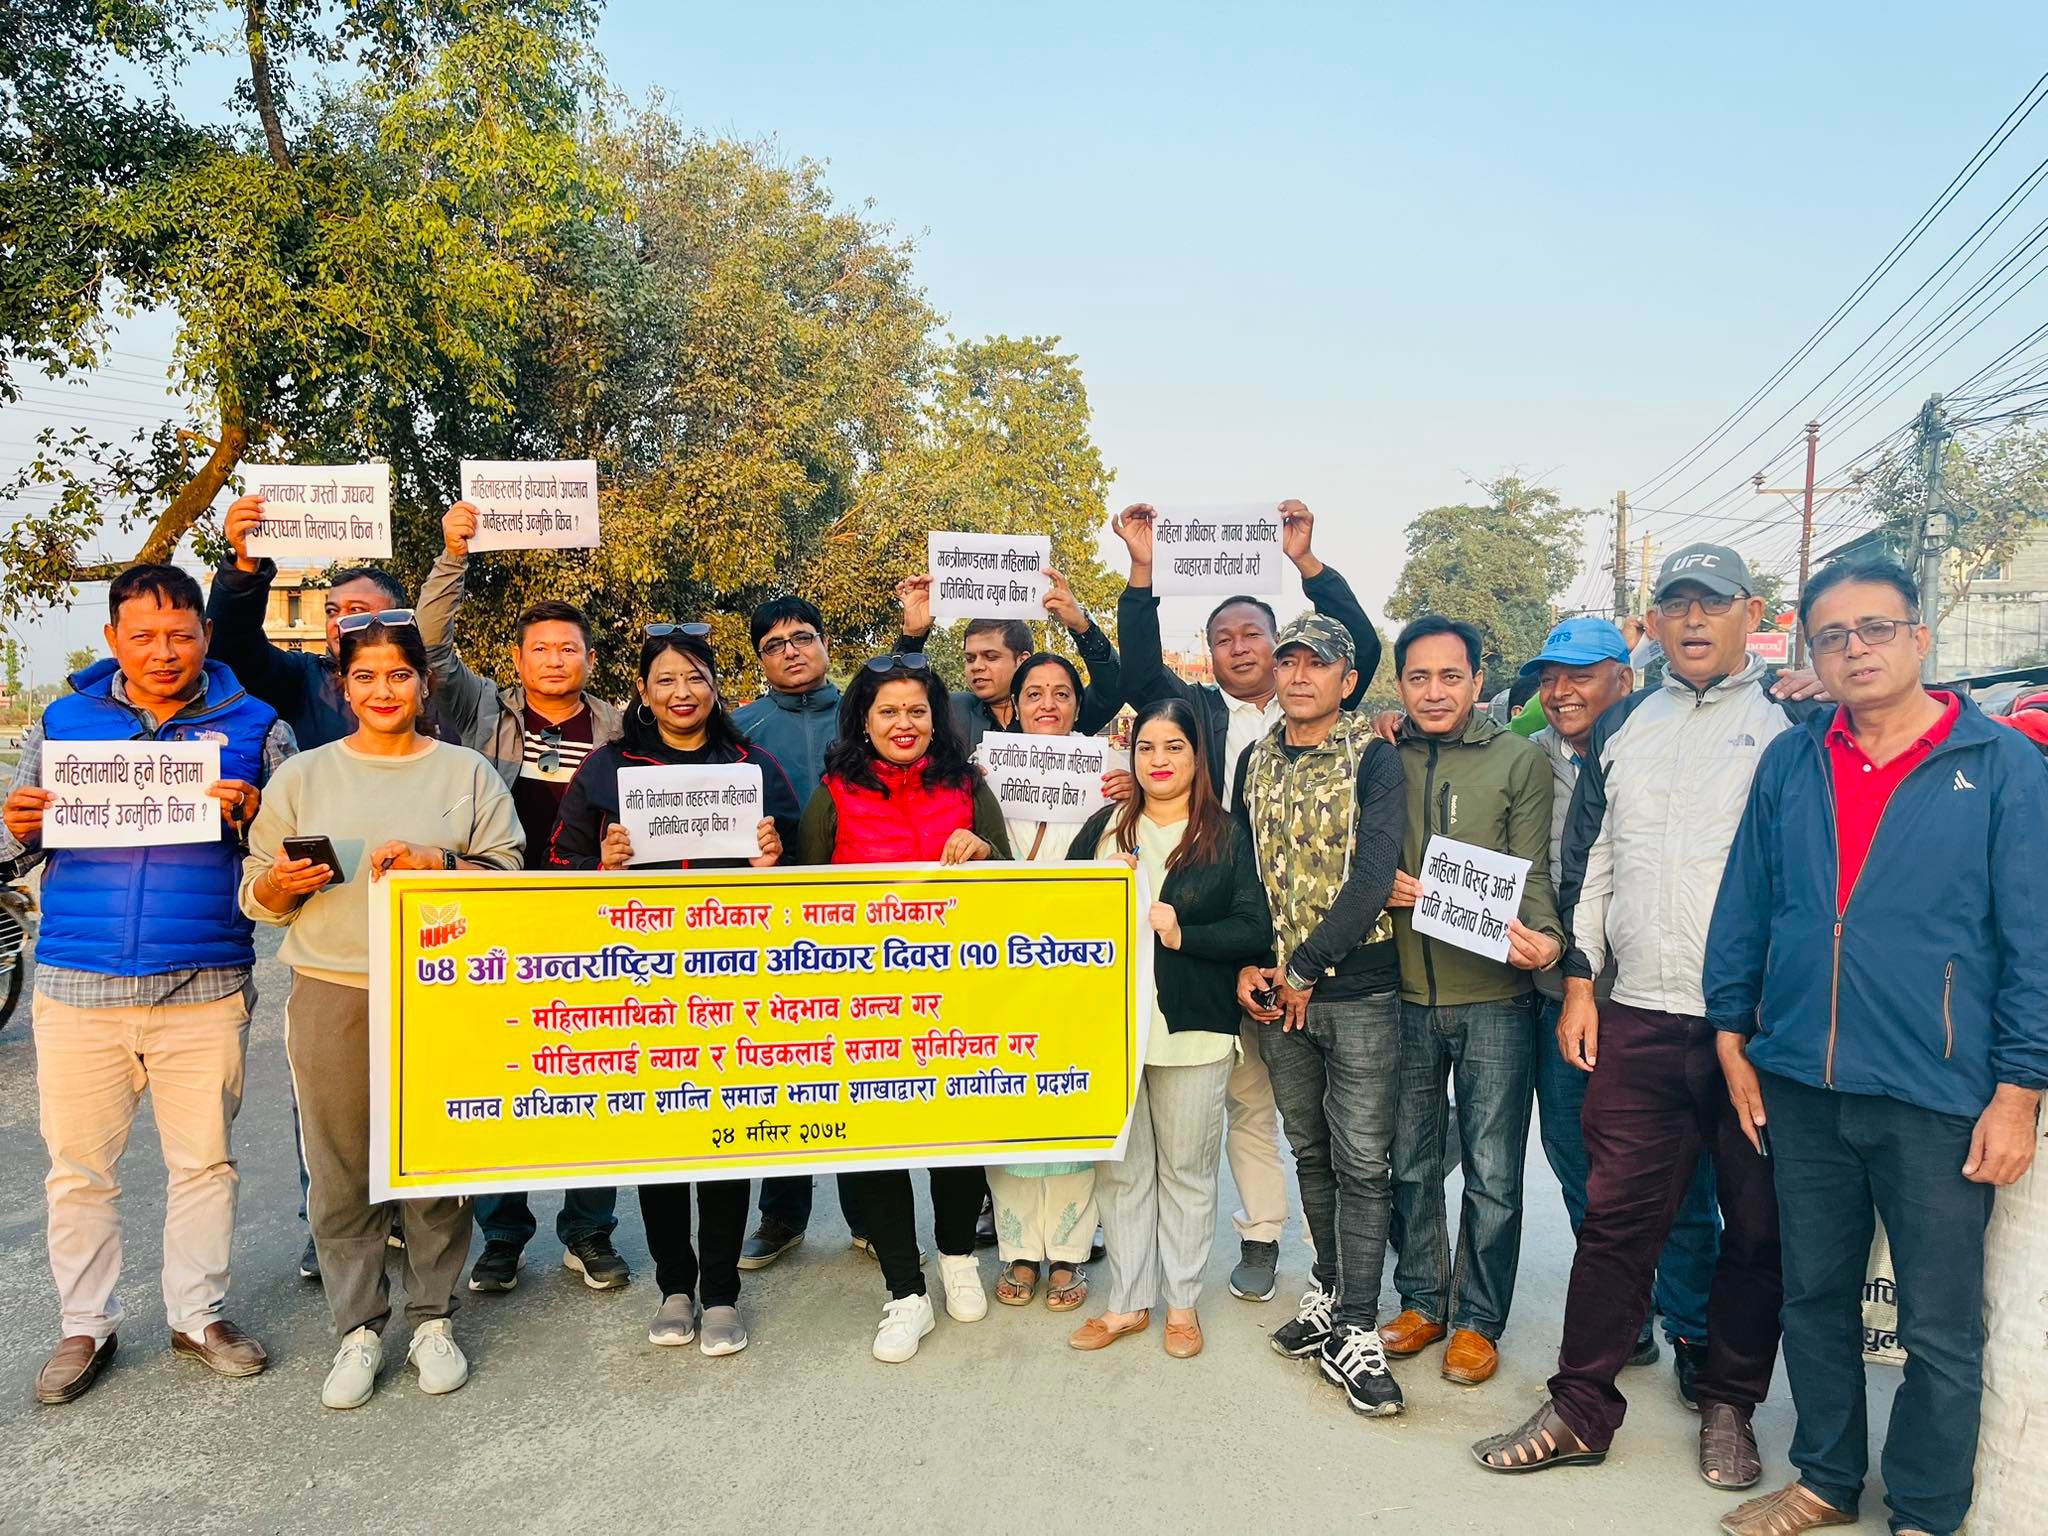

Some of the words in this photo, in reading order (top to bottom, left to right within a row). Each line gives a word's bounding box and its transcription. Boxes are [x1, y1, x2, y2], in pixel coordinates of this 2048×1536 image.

[311, 480, 337, 504] जस्तो
[342, 485, 375, 504] जघन्य
[560, 481, 589, 499] अपमान
[305, 514, 346, 540] मिलापत्र
[351, 515, 373, 540] किन
[555, 509, 572, 531] किन
[1157, 518, 1182, 543] महिला
[1221, 524, 1243, 542] मानव
[938, 546, 998, 570] मन्त्रीमण्डलमा
[1001, 549, 1041, 573] महिलाको
[1174, 557, 1211, 577] व्यवहारमा
[1214, 551, 1243, 577] चरितार्थ
[1672, 553, 1721, 572] UFC
[940, 577, 984, 601] प्रतिनिधित्व
[987, 584, 1006, 607] न्युन
[1009, 580, 1029, 602] किन
[54, 754, 129, 786] महिलामाथि
[134, 755, 155, 790] हुने
[159, 754, 204, 786] हिंसामा
[989, 743, 1028, 772] कुटनीतिक
[1030, 744, 1066, 775] नियुक्तिमा
[1067, 748, 1103, 774] महिलाको
[625, 786, 644, 810] नीति
[646, 788, 683, 810] निर्माणका
[722, 784, 758, 807] महिलाको
[1000, 777, 1040, 805] प्रतिनिधित्व
[1042, 786, 1061, 810] न्युन
[1061, 782, 1080, 806] किन
[55, 797, 110, 829] दोषीलाई
[115, 796, 163, 831] उन्मुक्ति
[168, 796, 195, 824] किन
[202, 803, 208, 823] ?
[648, 813, 689, 839] प्रतिनिधित्व
[692, 817, 710, 837] न्युन
[712, 812, 729, 832] किन
[1428, 851, 1461, 885] महिला
[686, 898, 772, 930] अधिकार
[802, 903, 856, 924] मानव
[1421, 890, 1442, 919] पनि
[1441, 896, 1479, 931] भेदभाव
[418, 958, 455, 982] ७४
[516, 945, 676, 983] अन्तर्राष्ट्रिय
[684, 950, 758, 974] मानव
[766, 941, 876, 972] अधिकार
[883, 938, 951, 969] दिवस
[960, 943, 997, 966] (१०
[1008, 935, 1114, 966] डिसेम्बर)
[532, 996, 678, 1034] महिलामाथिको
[687, 994, 735, 1028] हिंसा
[743, 1001, 761, 1026] र
[769, 994, 841, 1024] भेदभाव
[850, 995, 903, 1019] अन्त्य
[911, 994, 943, 1019] गर
[531, 1042, 641, 1076] पीडितलाई
[649, 1047, 700, 1069] न्याय
[709, 1046, 727, 1071] र
[735, 1034, 836, 1067] पिडकलाई
[844, 1038, 902, 1063] सजाय
[911, 1028, 1000, 1066] सुनिश्चित
[1007, 1034, 1039, 1058] गर
[446, 1098, 503, 1120] मानव
[513, 1088, 598, 1118] अधिकार
[606, 1092, 646, 1114] तथा
[655, 1081, 713, 1113] शान्ति
[721, 1085, 779, 1110] समाज
[786, 1082, 840, 1104] झापा
[849, 1078, 937, 1104] शाखाद्वारा
[946, 1067, 1028, 1097] आयोजित
[1035, 1065, 1090, 1096] प्रदर्शन
[712, 1127, 735, 1149] २४
[799, 1121, 847, 1144] २०७९
